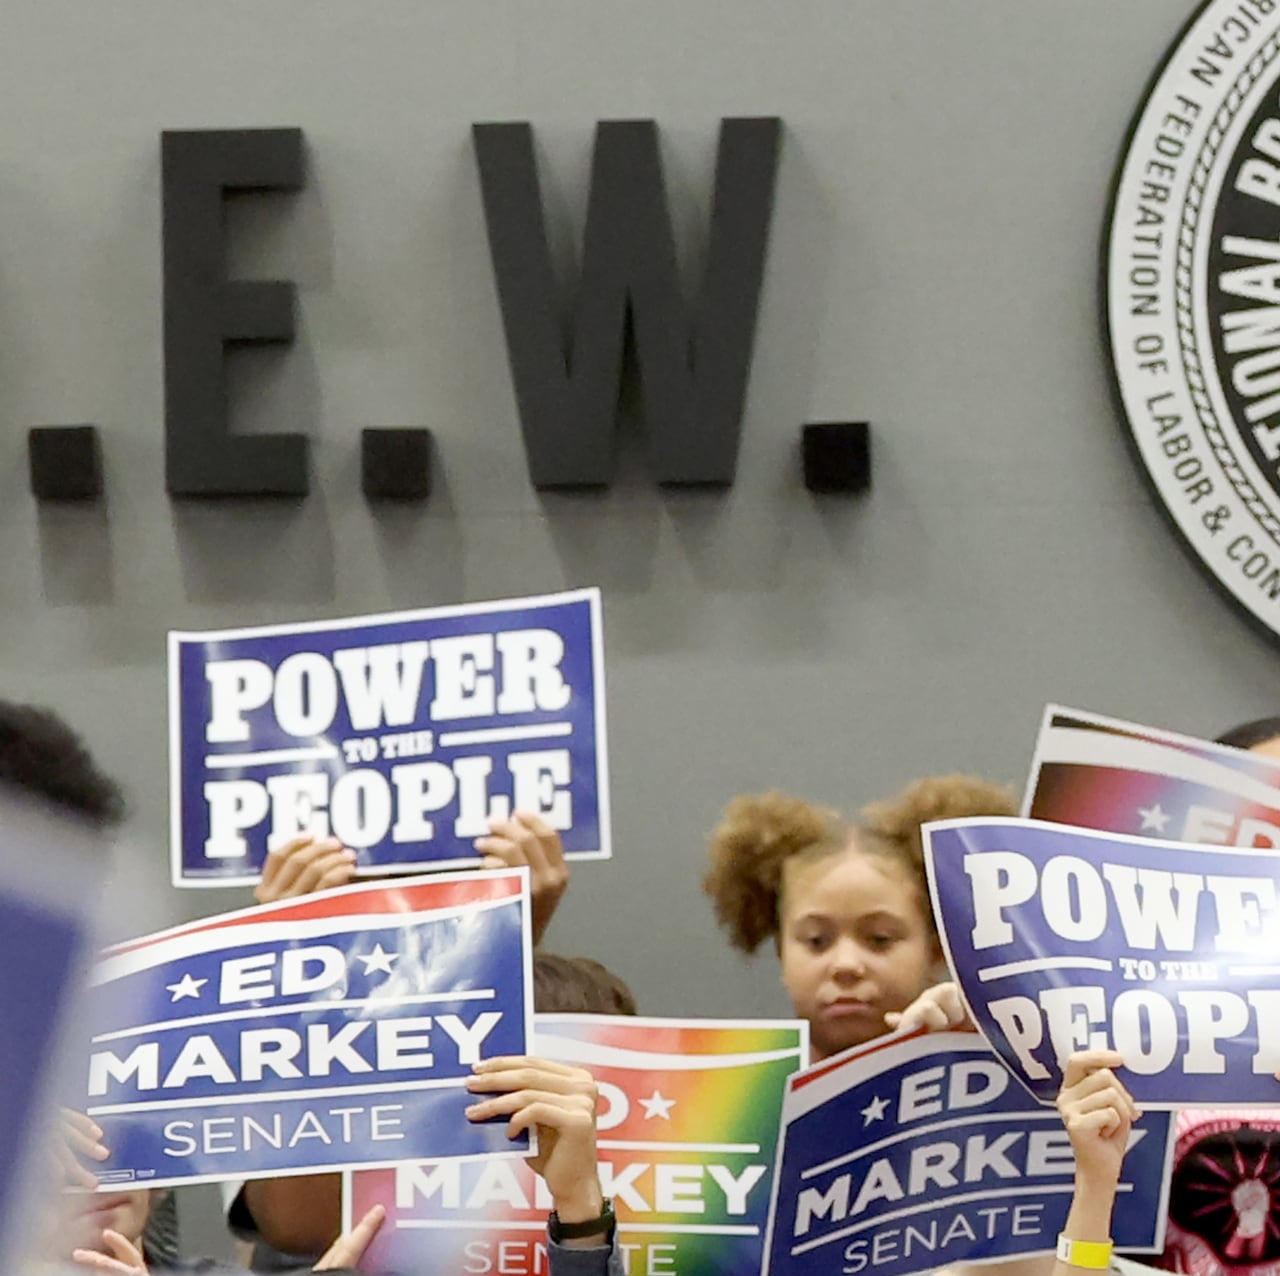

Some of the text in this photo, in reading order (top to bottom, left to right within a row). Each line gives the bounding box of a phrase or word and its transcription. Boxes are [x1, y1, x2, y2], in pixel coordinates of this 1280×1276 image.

[1130, 93, 1203, 317] FEDERATION
[1133, 333, 1170, 376] OF
[1145, 390, 1216, 506] LABOR
[1201, 504, 1233, 538] &
[205, 628, 572, 744] POWER
[342, 729, 435, 764] TO THE
[203, 748, 573, 860] PEOPLE
[218, 944, 348, 1005] ED
[1118, 958, 1219, 982] TO THE
[86, 1010, 505, 1097] MARKEY
[896, 1058, 1010, 1124] ED
[162, 1104, 406, 1159] SENATE
[793, 1127, 1150, 1238] MARKE
[841, 1203, 1045, 1275] SENATE
